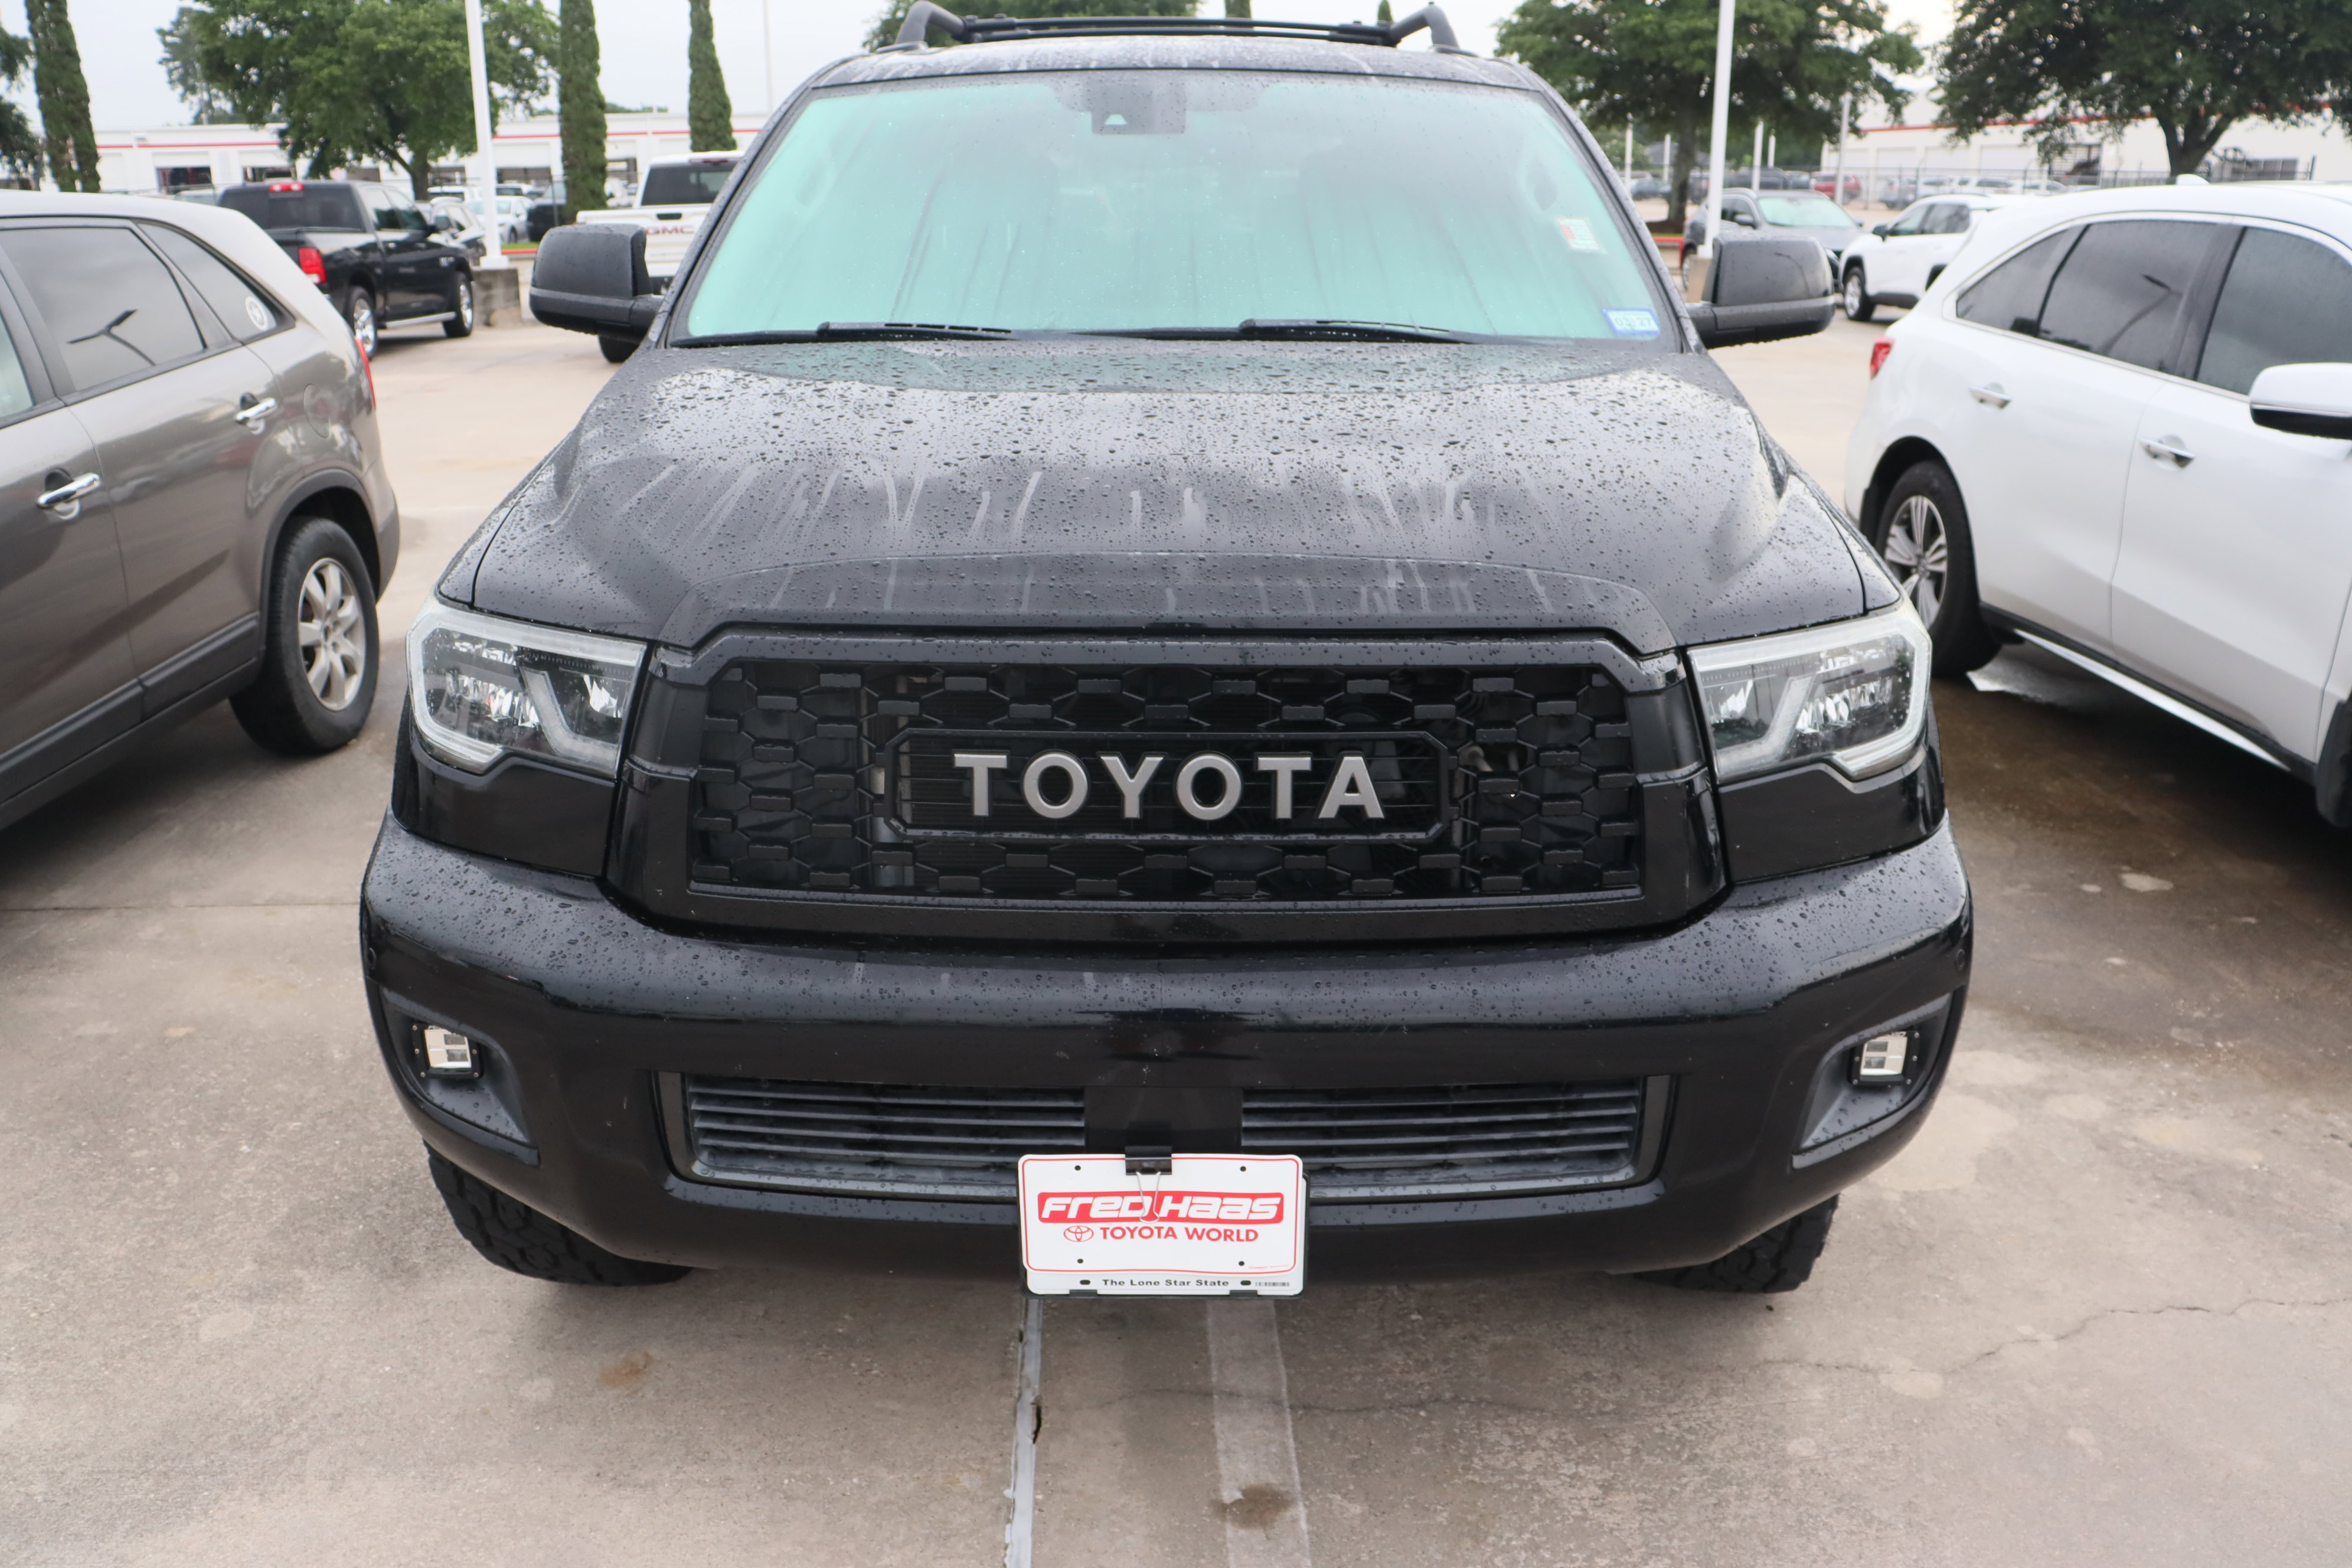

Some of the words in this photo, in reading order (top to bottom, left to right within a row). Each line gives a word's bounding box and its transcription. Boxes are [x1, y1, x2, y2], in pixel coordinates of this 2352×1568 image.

[645, 226, 695, 234] GMC
[953, 752, 1386, 821] TOYOTA
[1100, 1226, 1178, 1240] TOYOTA
[1184, 1227, 1259, 1242] WORLD
